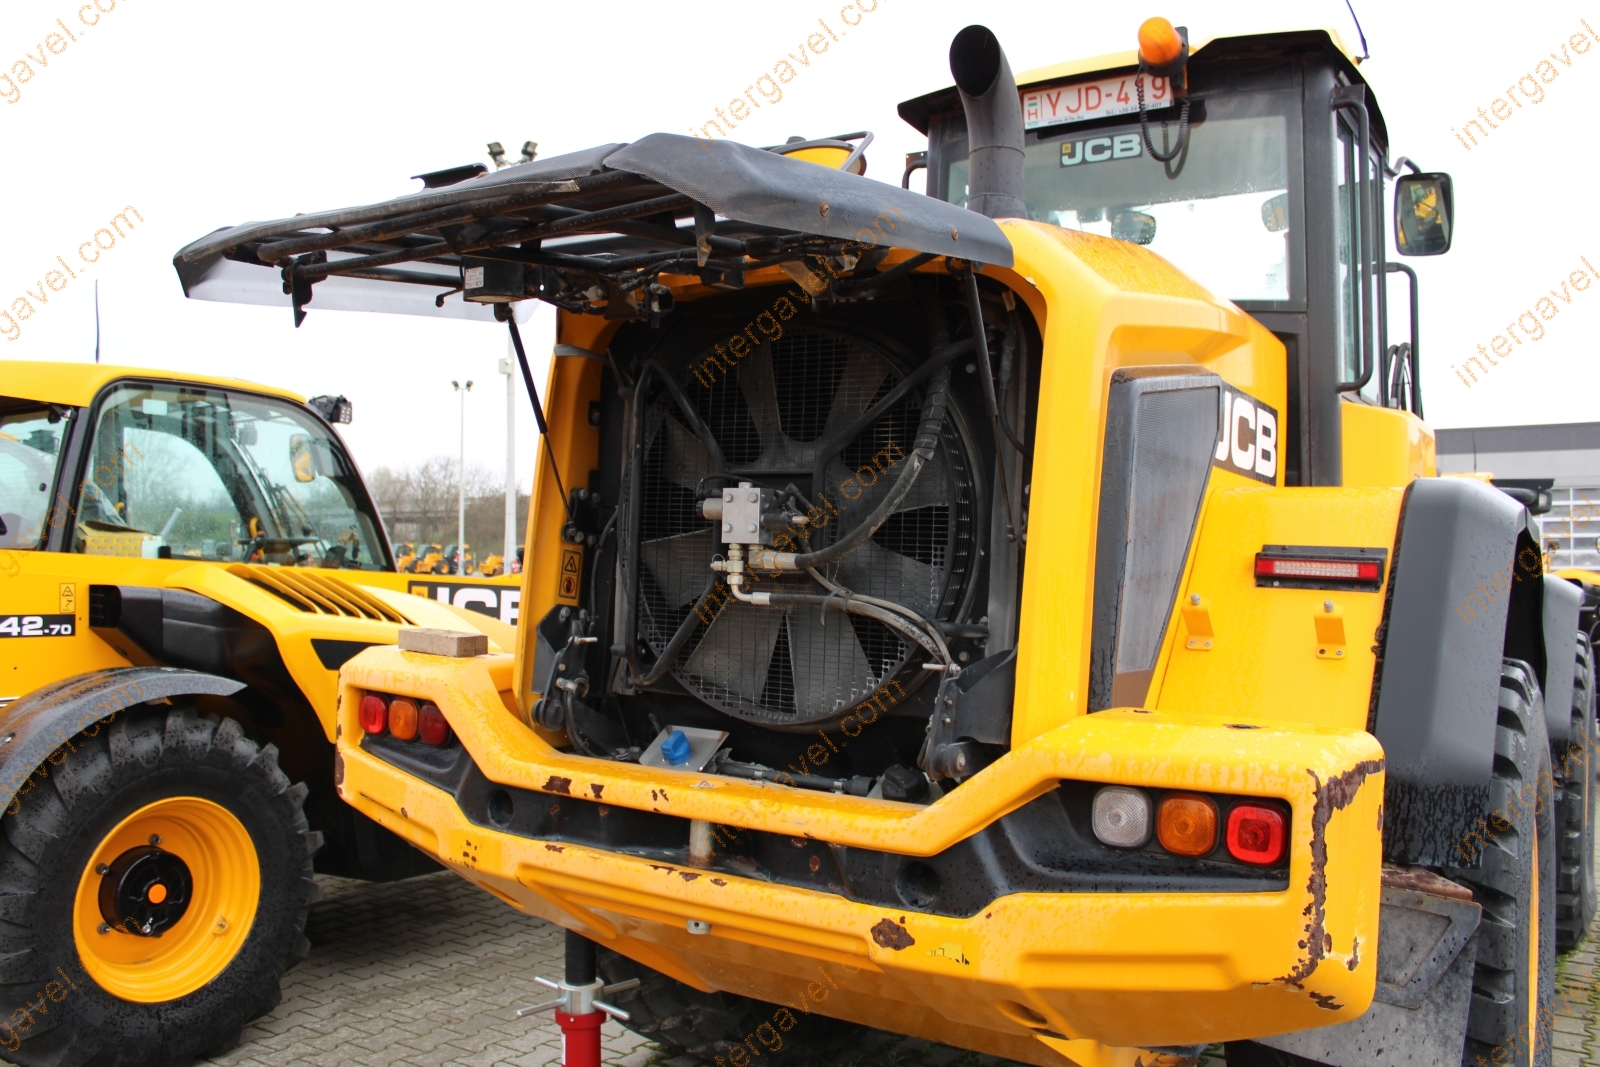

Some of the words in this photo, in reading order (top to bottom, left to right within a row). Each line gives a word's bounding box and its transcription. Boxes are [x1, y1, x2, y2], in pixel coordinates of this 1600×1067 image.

[1047, 114, 1085, 125] www.kite.hu
[1061, 133, 1141, 166] JCB
[1215, 390, 1277, 478] JCB
